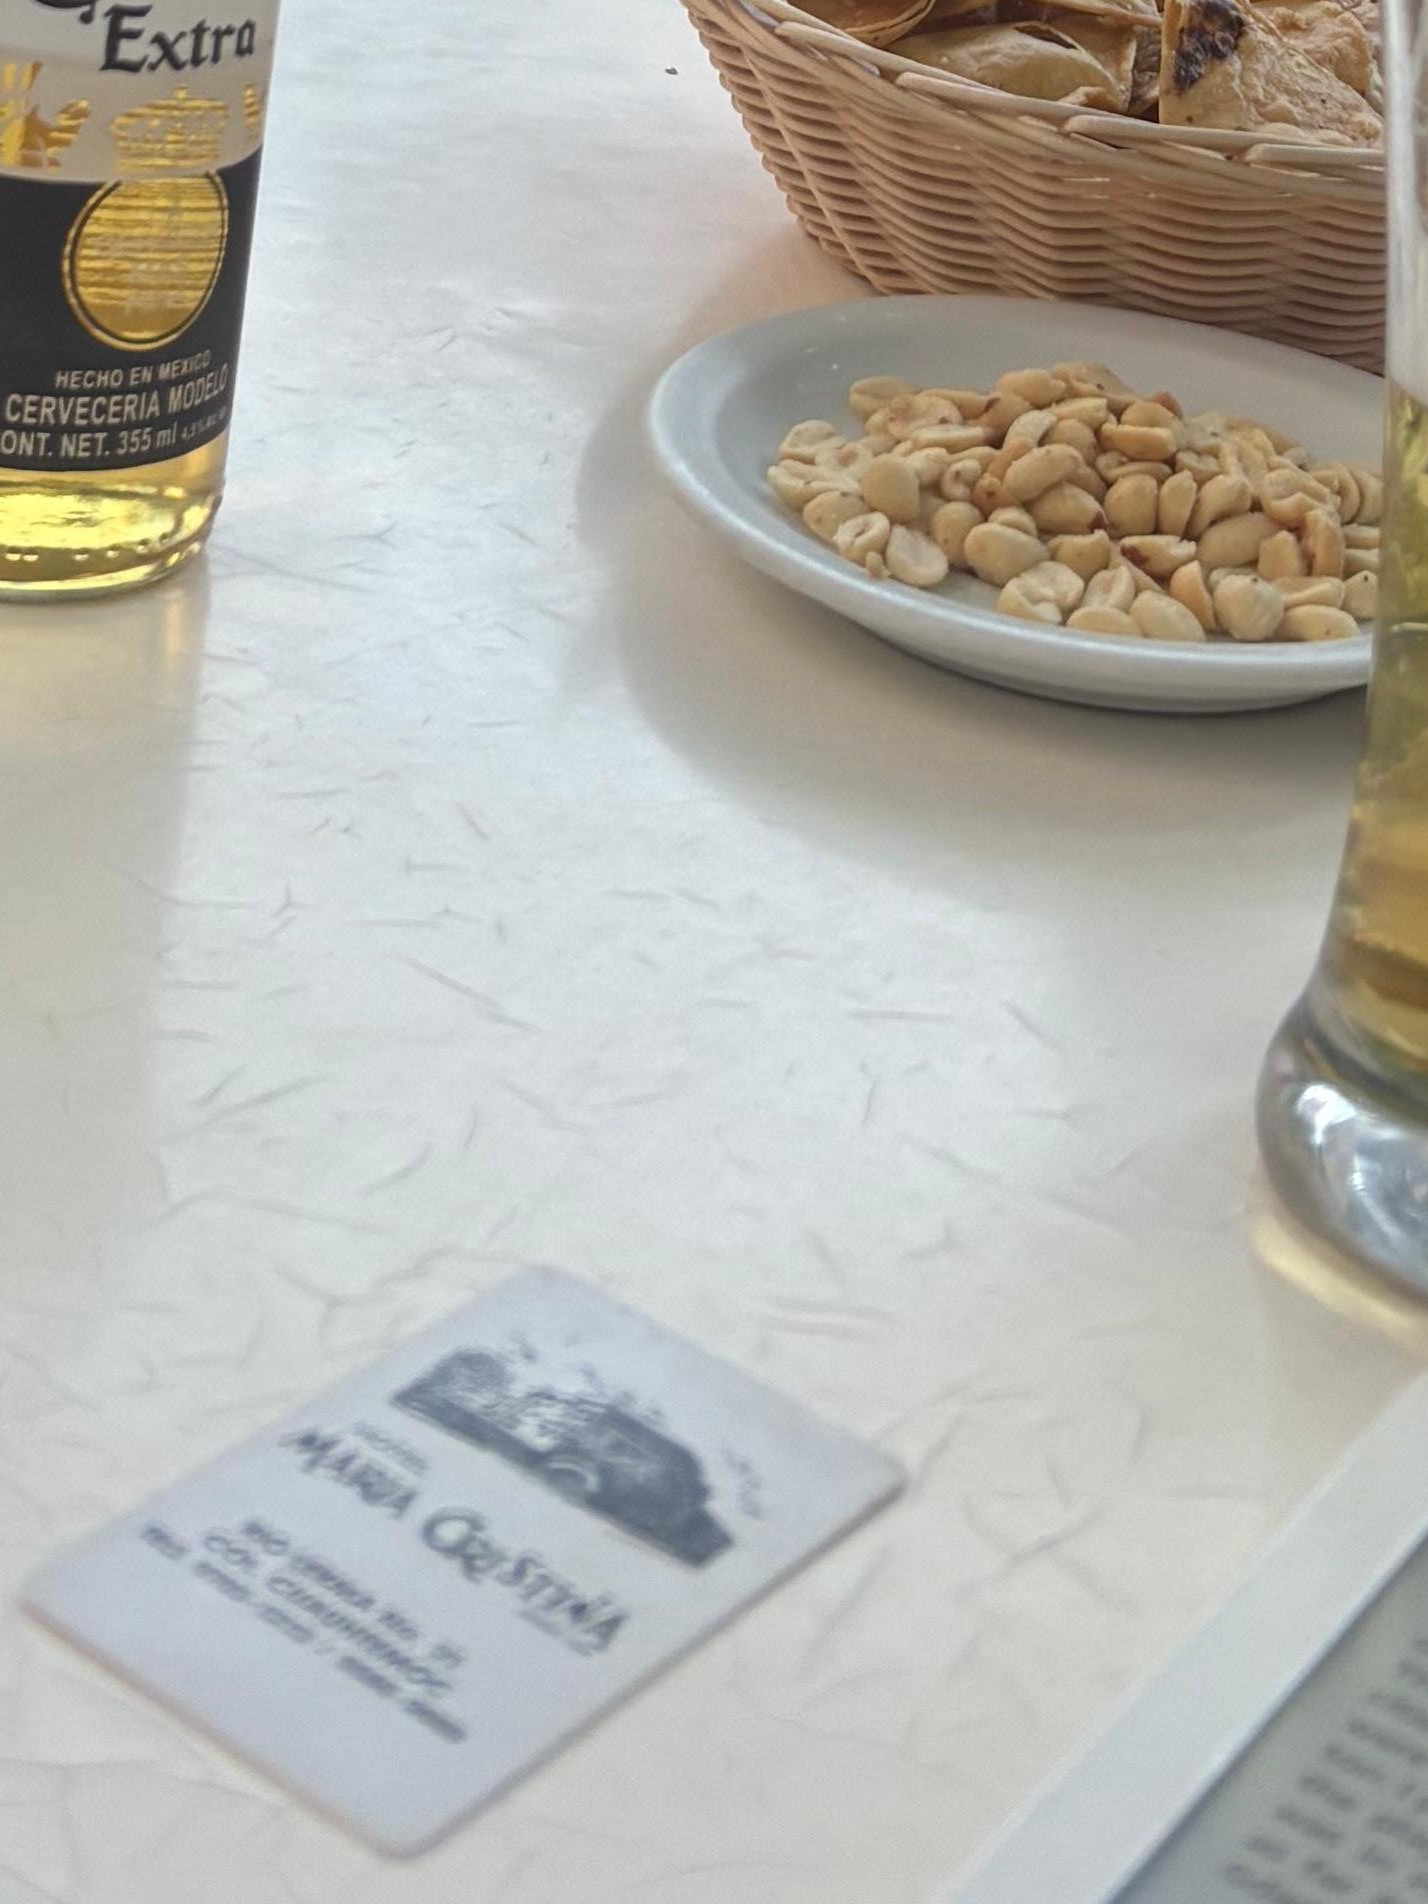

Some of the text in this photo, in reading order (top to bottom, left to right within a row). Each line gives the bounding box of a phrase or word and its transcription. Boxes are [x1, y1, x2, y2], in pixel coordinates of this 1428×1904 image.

[99, 3, 257, 73] Extra
[55, 368, 124, 390] HECHO
[129, 365, 154, 386] EN
[168, 362, 230, 415] MODELO
[60, 429, 110, 458] NET.
[118, 427, 152, 456] 355
[155, 421, 178, 447] ml
